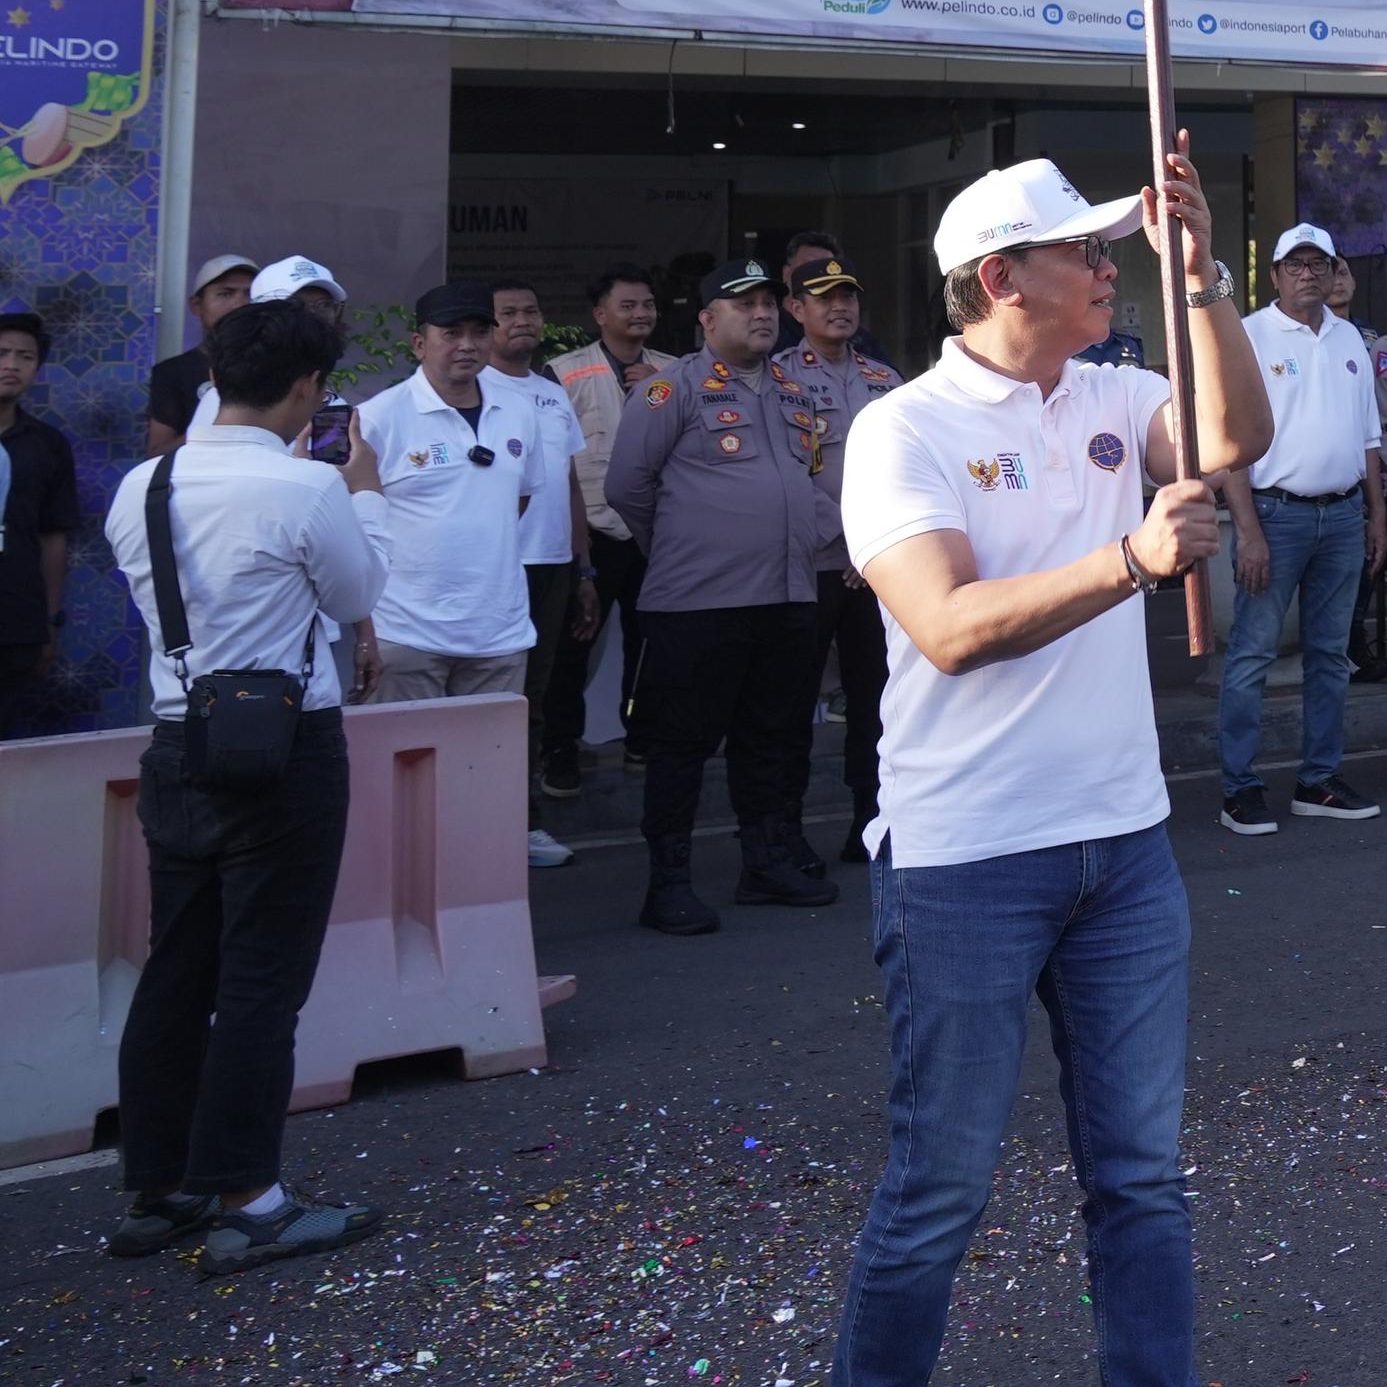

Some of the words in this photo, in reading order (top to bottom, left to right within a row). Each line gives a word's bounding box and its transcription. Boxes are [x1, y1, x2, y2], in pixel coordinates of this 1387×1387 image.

[823, 0, 866, 14] Peduli
[1066, 9, 1122, 27] @pelindo
[1219, 18, 1306, 35] @indonesiaport
[1331, 26, 1387, 40] Pelabuhan
